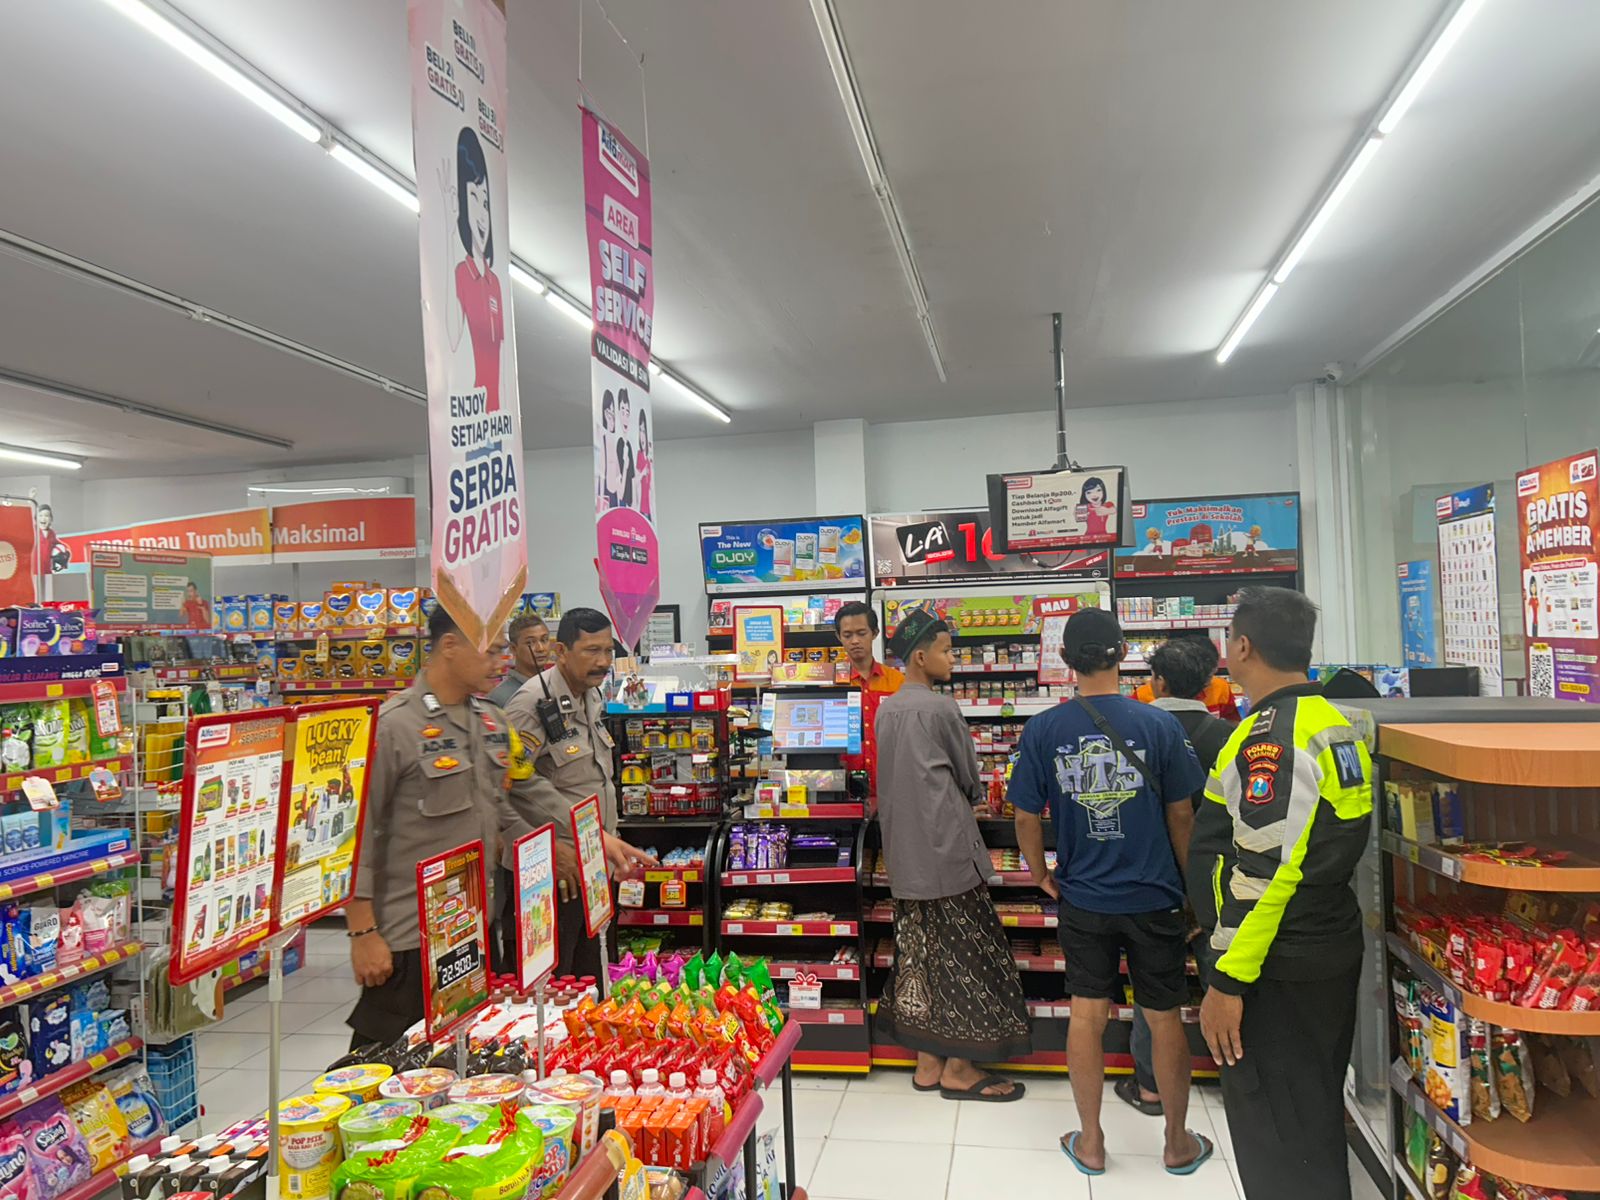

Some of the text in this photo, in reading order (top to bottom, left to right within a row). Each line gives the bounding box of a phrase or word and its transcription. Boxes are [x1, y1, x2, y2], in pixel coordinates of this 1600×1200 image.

[426, 46, 445, 71] BELI
[427, 66, 457, 99] GRATIS
[608, 205, 635, 240] AREA
[599, 240, 647, 295] SELF
[596, 285, 652, 347] SERVICE
[450, 392, 485, 418] ENJOY
[451, 415, 512, 447] SETIAP HARI
[450, 454, 517, 513] SERBA
[1526, 491, 1588, 525] GRATIS
[139, 535, 181, 552] mau
[186, 527, 263, 551] Tumbuh
[273, 521, 365, 545] Maksimal
[445, 497, 520, 563] GRATIS
[716, 552, 754, 563] DJOY
[1040, 600, 1070, 613] MAU
[23, 619, 49, 630] Softex
[306, 719, 361, 748] LUCKY
[34, 917, 58, 931] GUARD
[442, 954, 472, 985] 22.900
[291, 1137, 306, 1145] POP
